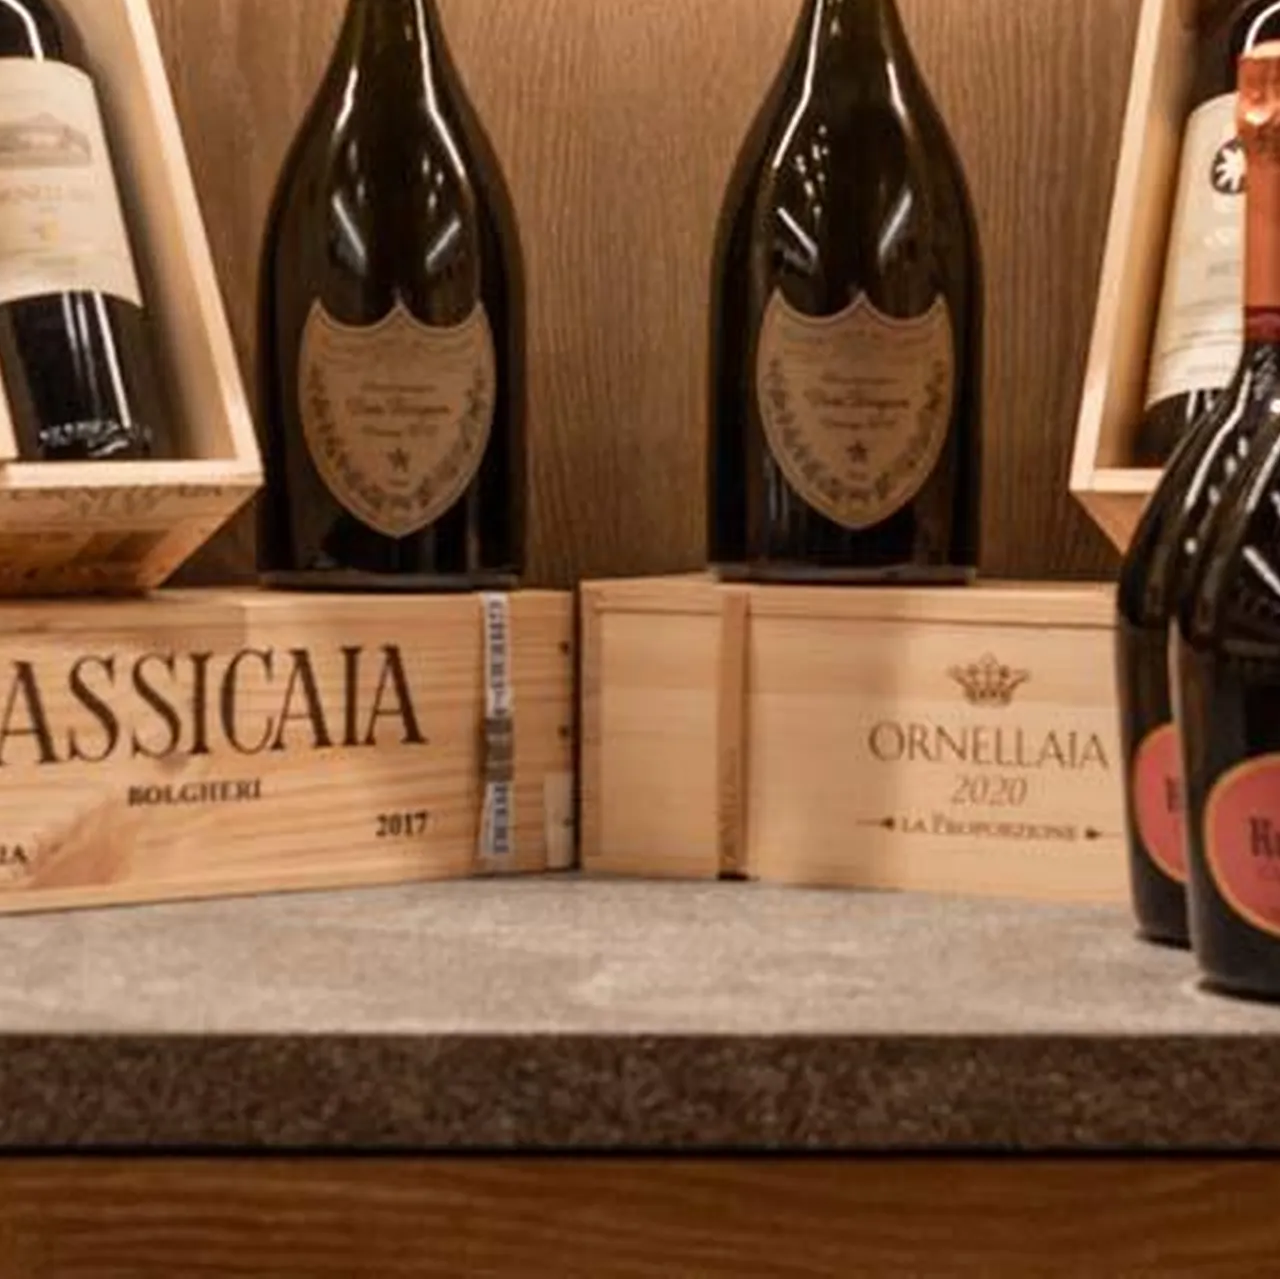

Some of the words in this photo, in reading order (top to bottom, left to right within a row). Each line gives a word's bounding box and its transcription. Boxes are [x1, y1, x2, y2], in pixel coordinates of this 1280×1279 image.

[868, 720, 1110, 770] ORNELLAIA
[127, 778, 262, 807] BOLGHERI
[949, 773, 1029, 807] 2020
[375, 810, 429, 838] 2017
